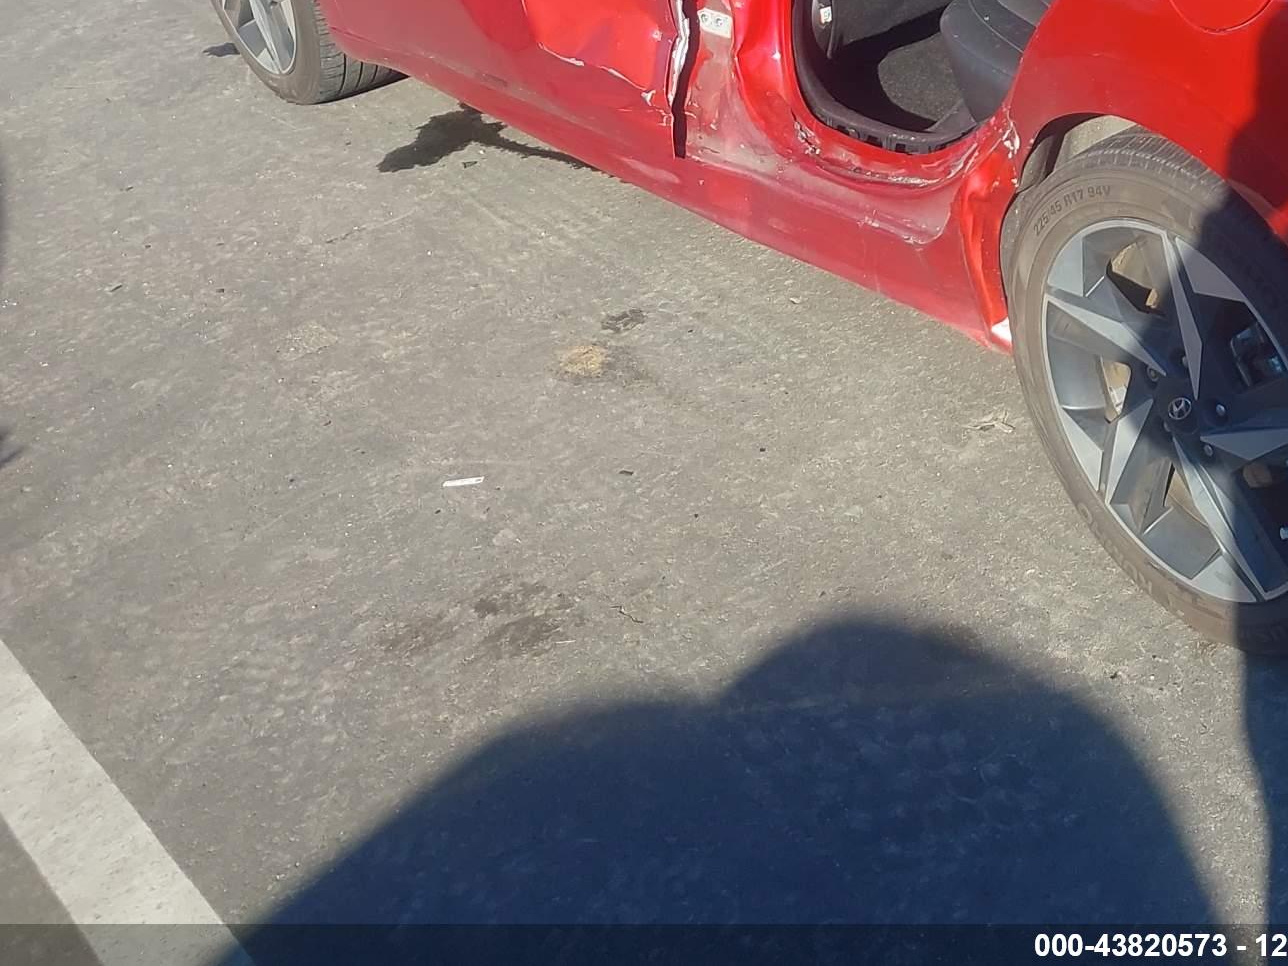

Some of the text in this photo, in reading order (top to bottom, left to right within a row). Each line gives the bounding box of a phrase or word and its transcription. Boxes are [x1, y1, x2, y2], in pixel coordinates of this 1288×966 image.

[1033, 185, 1111, 237] 225/45 R17 94V
